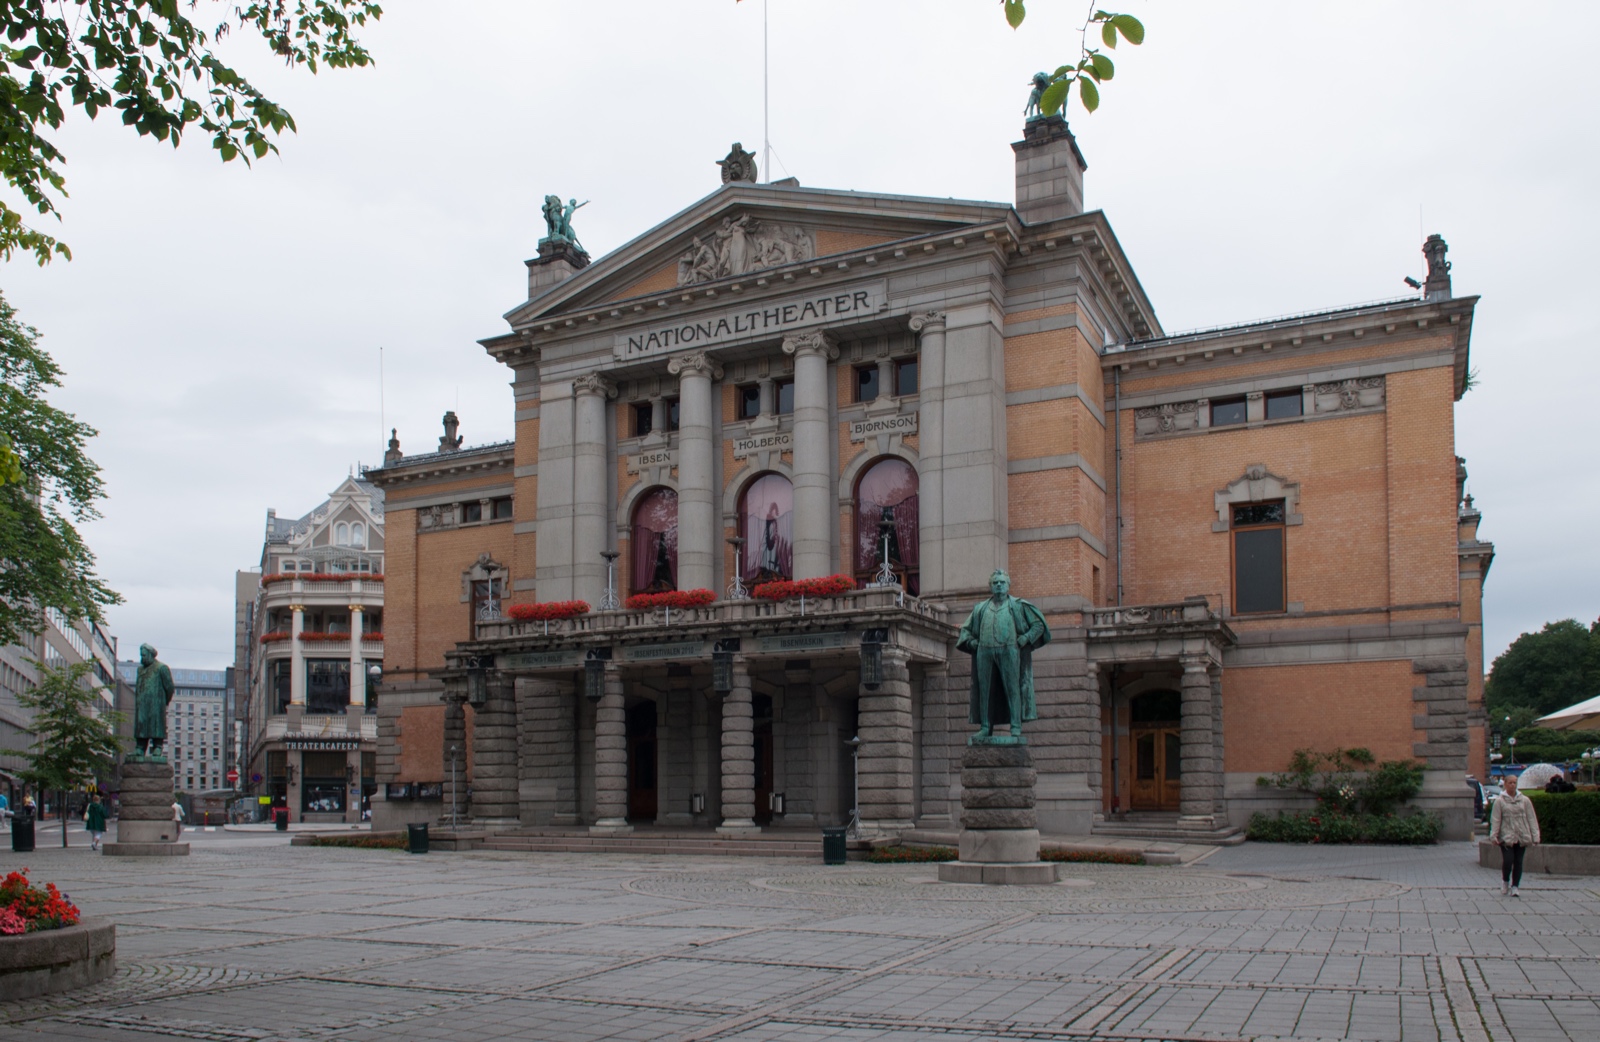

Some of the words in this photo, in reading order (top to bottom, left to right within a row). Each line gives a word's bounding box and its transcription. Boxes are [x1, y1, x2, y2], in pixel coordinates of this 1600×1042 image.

[628, 291, 870, 354] NATIONALTHEATER
[855, 416, 914, 434] BJØRNSON
[739, 435, 789, 450] HOLBERG
[639, 452, 671, 465] IBSEN
[780, 637, 824, 648] IBSENMASKIN
[633, 648, 681, 658] IBSENFESTIVALEN
[681, 646, 694, 655] 2010
[286, 742, 358, 750] THEATERCAFEEN
